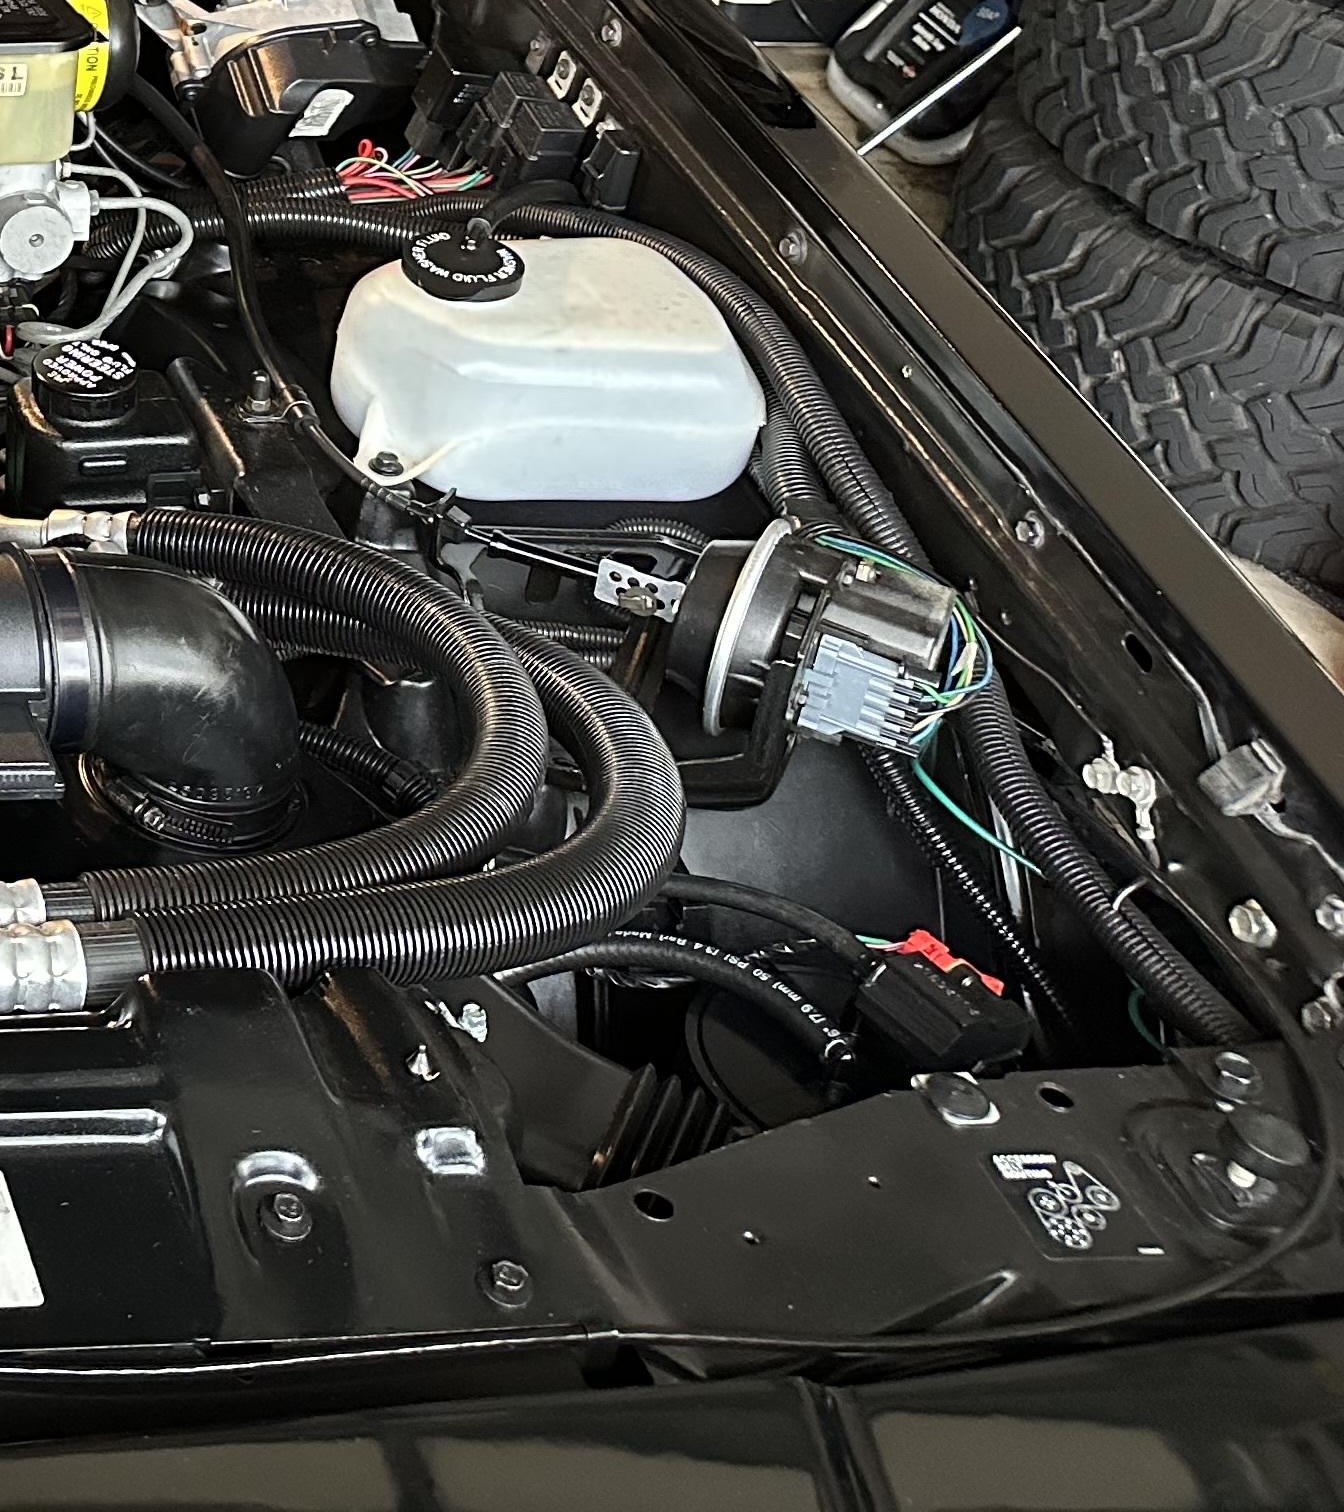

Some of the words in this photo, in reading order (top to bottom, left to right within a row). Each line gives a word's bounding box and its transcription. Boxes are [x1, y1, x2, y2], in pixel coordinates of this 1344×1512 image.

[11, 66, 24, 81] L
[723, 954, 750, 970] PSI
[753, 968, 772, 981] 50
